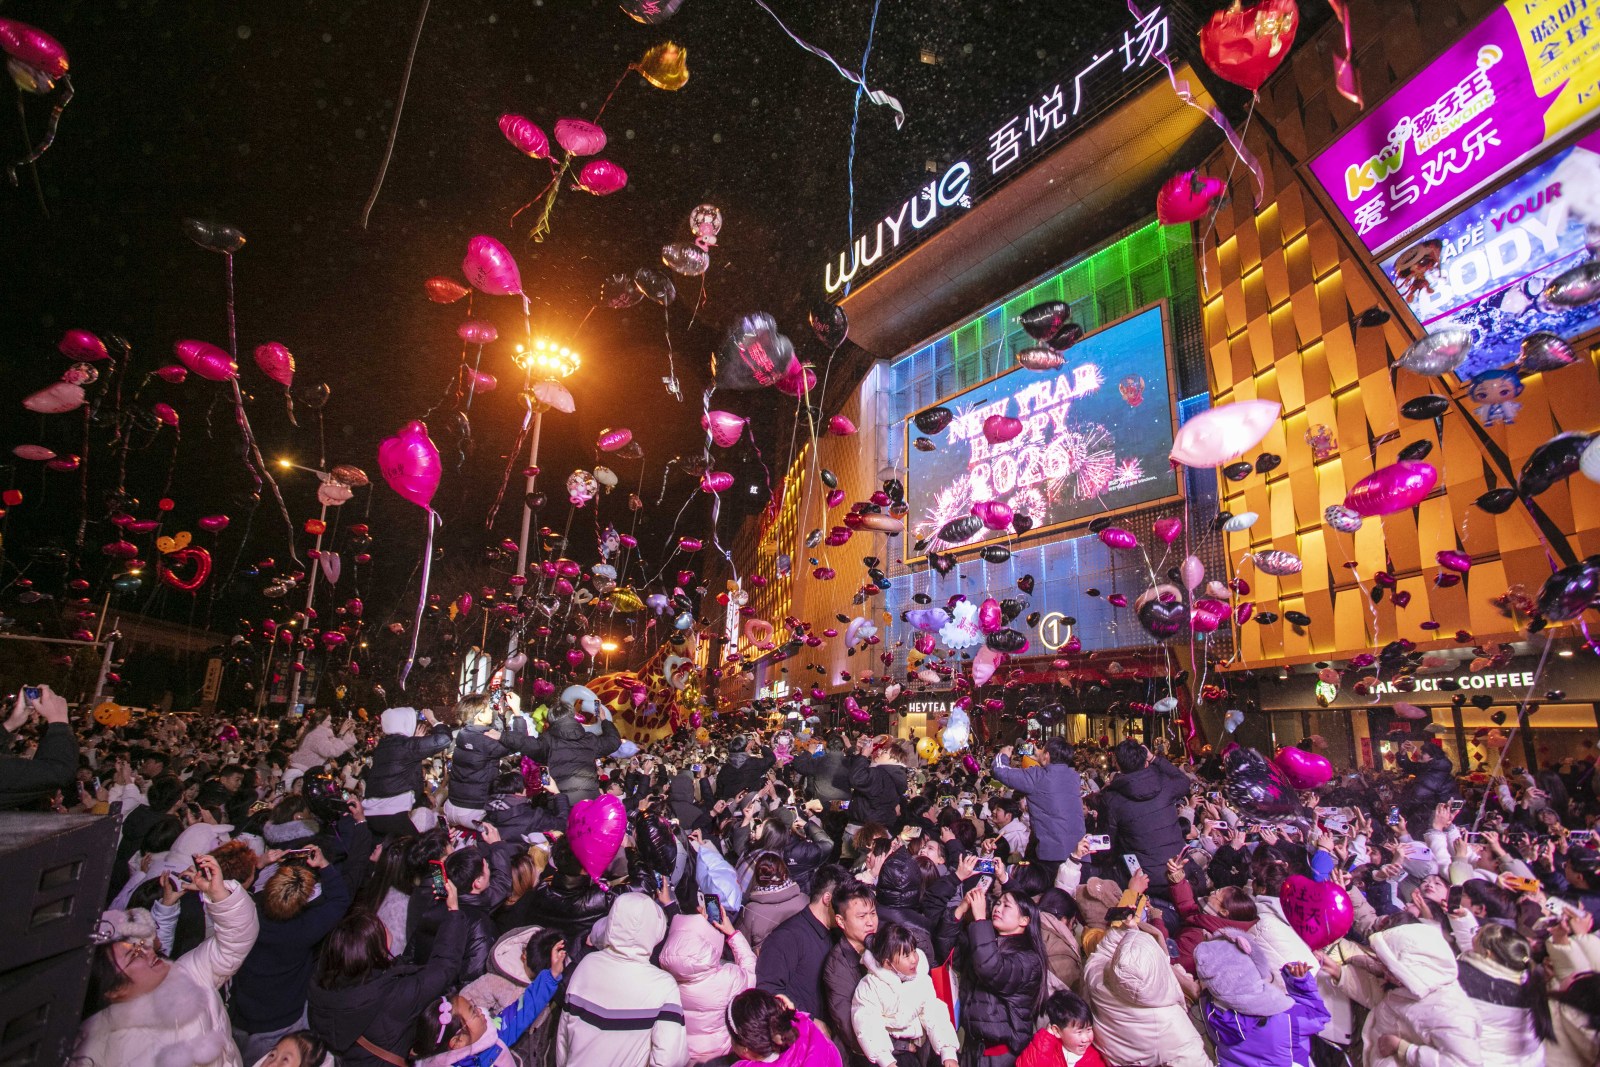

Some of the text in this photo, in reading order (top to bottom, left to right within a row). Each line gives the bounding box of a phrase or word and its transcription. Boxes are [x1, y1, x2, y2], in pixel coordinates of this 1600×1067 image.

[1539, 8, 1600, 68] 全球
[987, 6, 1169, 175] 吾悦广场
[1418, 93, 1493, 153] kidswant
[1354, 118, 1501, 236] 爱与欢乐
[1419, 201, 1566, 312] BODY
[1442, 223, 1485, 264] APE
[1490, 182, 1563, 233] YOUR
[949, 363, 1100, 445] NEW YEAR
[908, 701, 946, 713] HEYTEA
[1458, 671, 1536, 690] COFFEE
